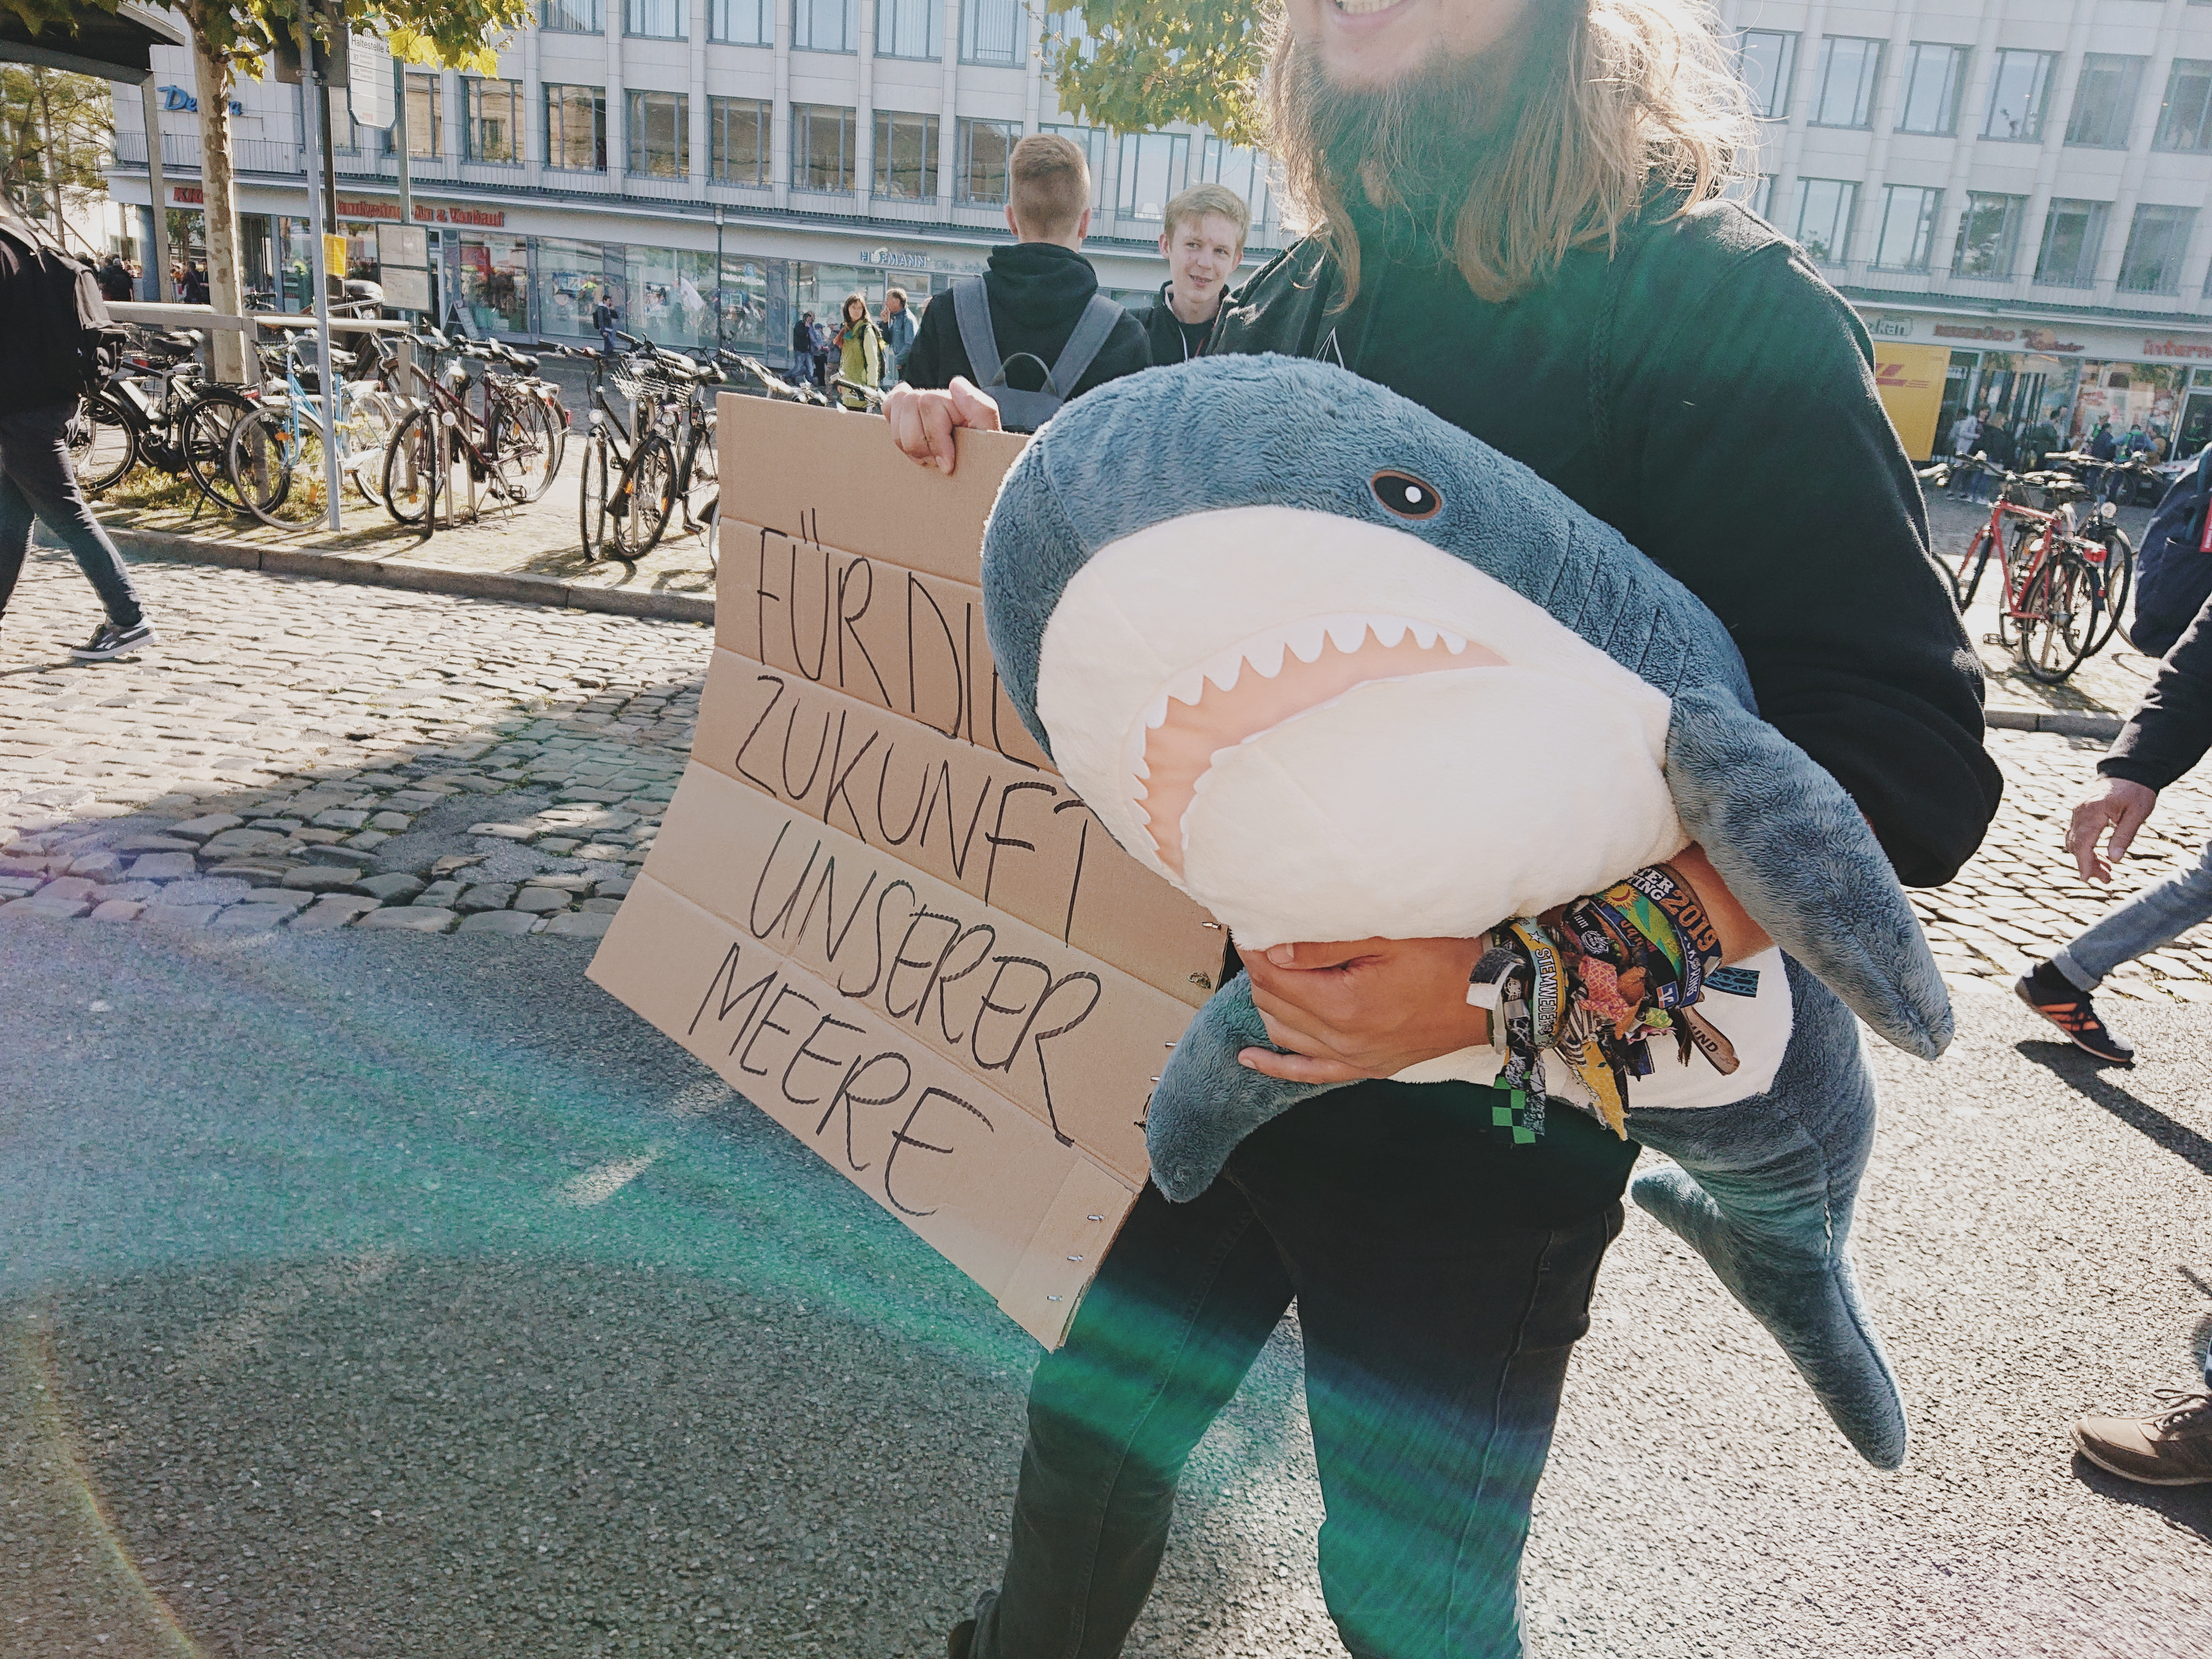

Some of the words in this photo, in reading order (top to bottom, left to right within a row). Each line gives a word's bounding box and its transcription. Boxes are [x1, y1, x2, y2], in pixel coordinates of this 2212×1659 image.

[352, 35, 384, 52] Haltestelle
[385, 46, 390, 55] 4
[414, 205, 433, 220] An
[436, 209, 447, 222] &
[449, 207, 504, 227] Verkauf
[757, 508, 892, 708] FÜR
[735, 675, 1088, 948] ZUKUNFT
[1627, 876, 1666, 900] TING
[1638, 868, 1674, 894] TER
[1659, 889, 1717, 952] 2019
[750, 819, 1101, 1148] UNSERER
[1535, 947, 1558, 1028] STEMWEDER
[688, 942, 994, 1216] MEERE
